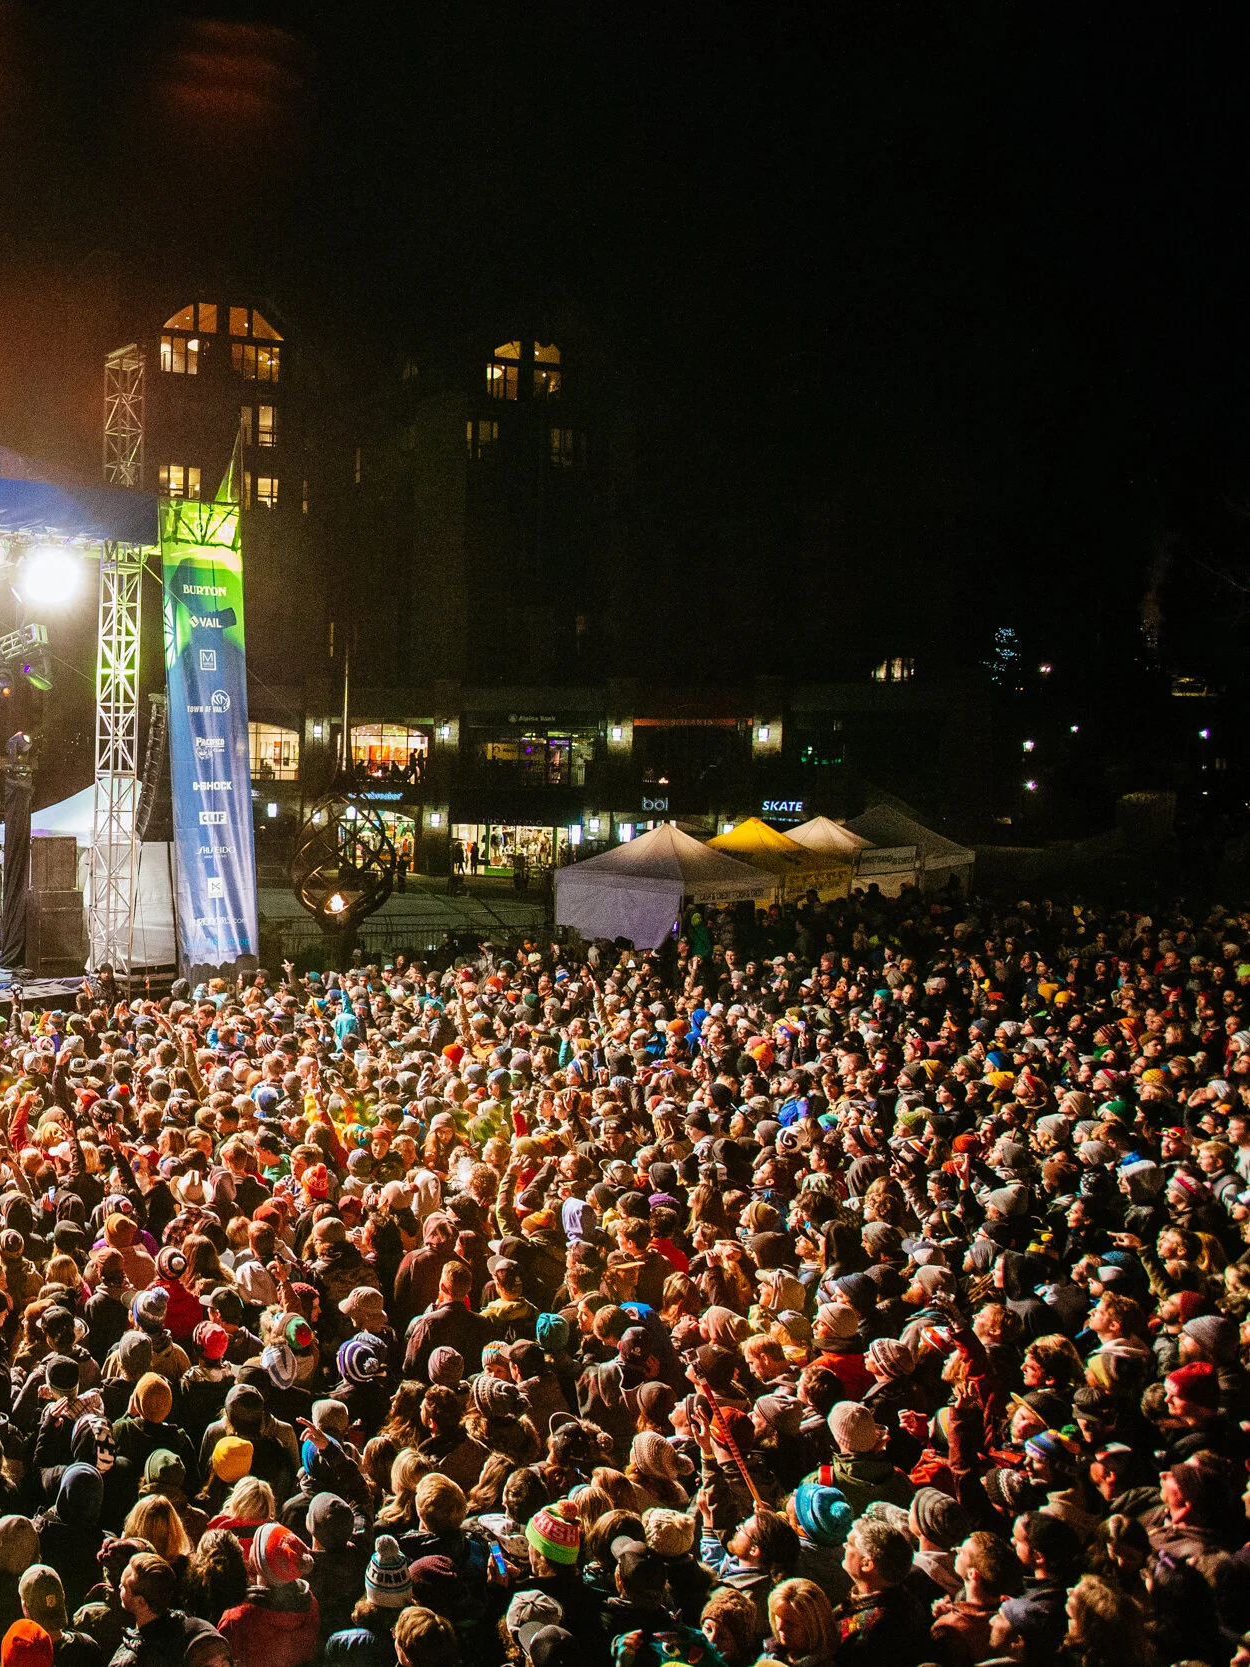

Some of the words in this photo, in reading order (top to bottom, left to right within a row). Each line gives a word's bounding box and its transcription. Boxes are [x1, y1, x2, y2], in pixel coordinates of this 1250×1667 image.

[183, 584, 227, 597] BURTON
[199, 617, 222, 629] VAIL
[186, 705, 204, 713] TOWN
[204, 705, 212, 713] OF
[761, 800, 803, 812] SKATE
[201, 813, 225, 823] CLIF
